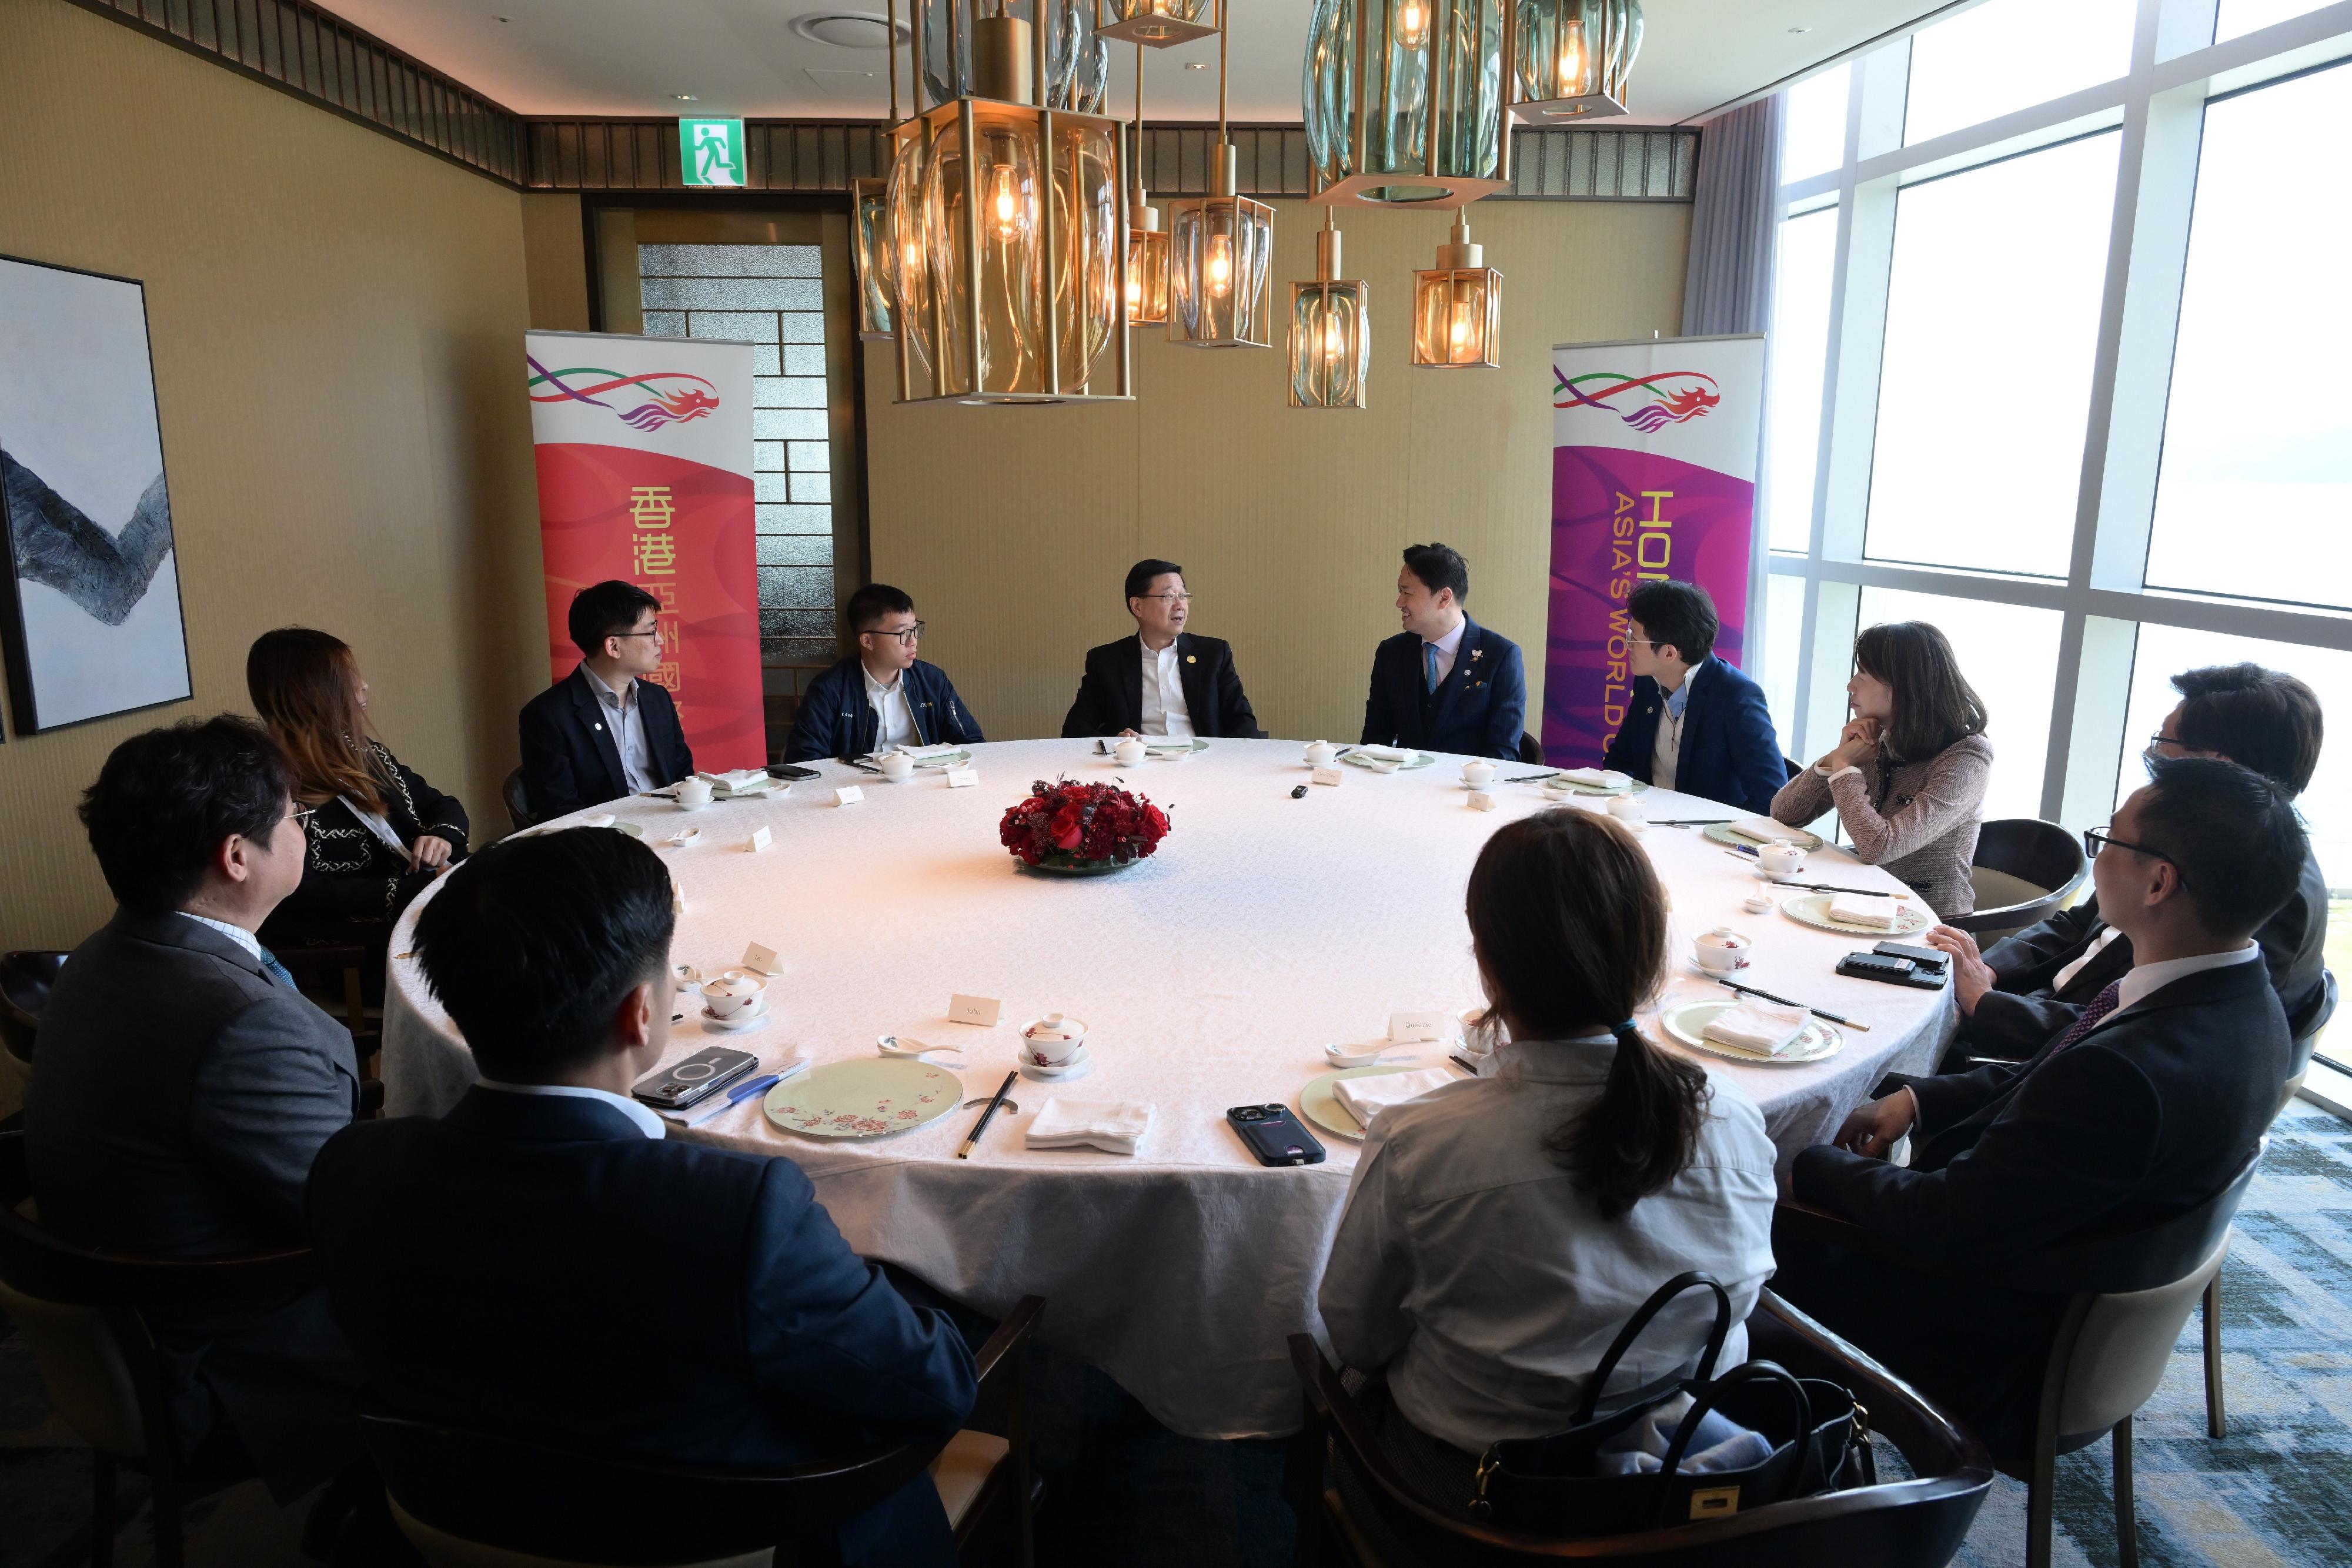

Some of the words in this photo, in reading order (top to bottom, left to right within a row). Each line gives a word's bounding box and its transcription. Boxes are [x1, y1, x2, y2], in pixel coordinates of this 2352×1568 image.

[629, 486, 676, 576] 香港
[1610, 491, 1635, 599] ASIA'S
[1636, 491, 1674, 580] HO
[1604, 608, 1629, 726] WORLD
[966, 1007, 981, 1015] John
